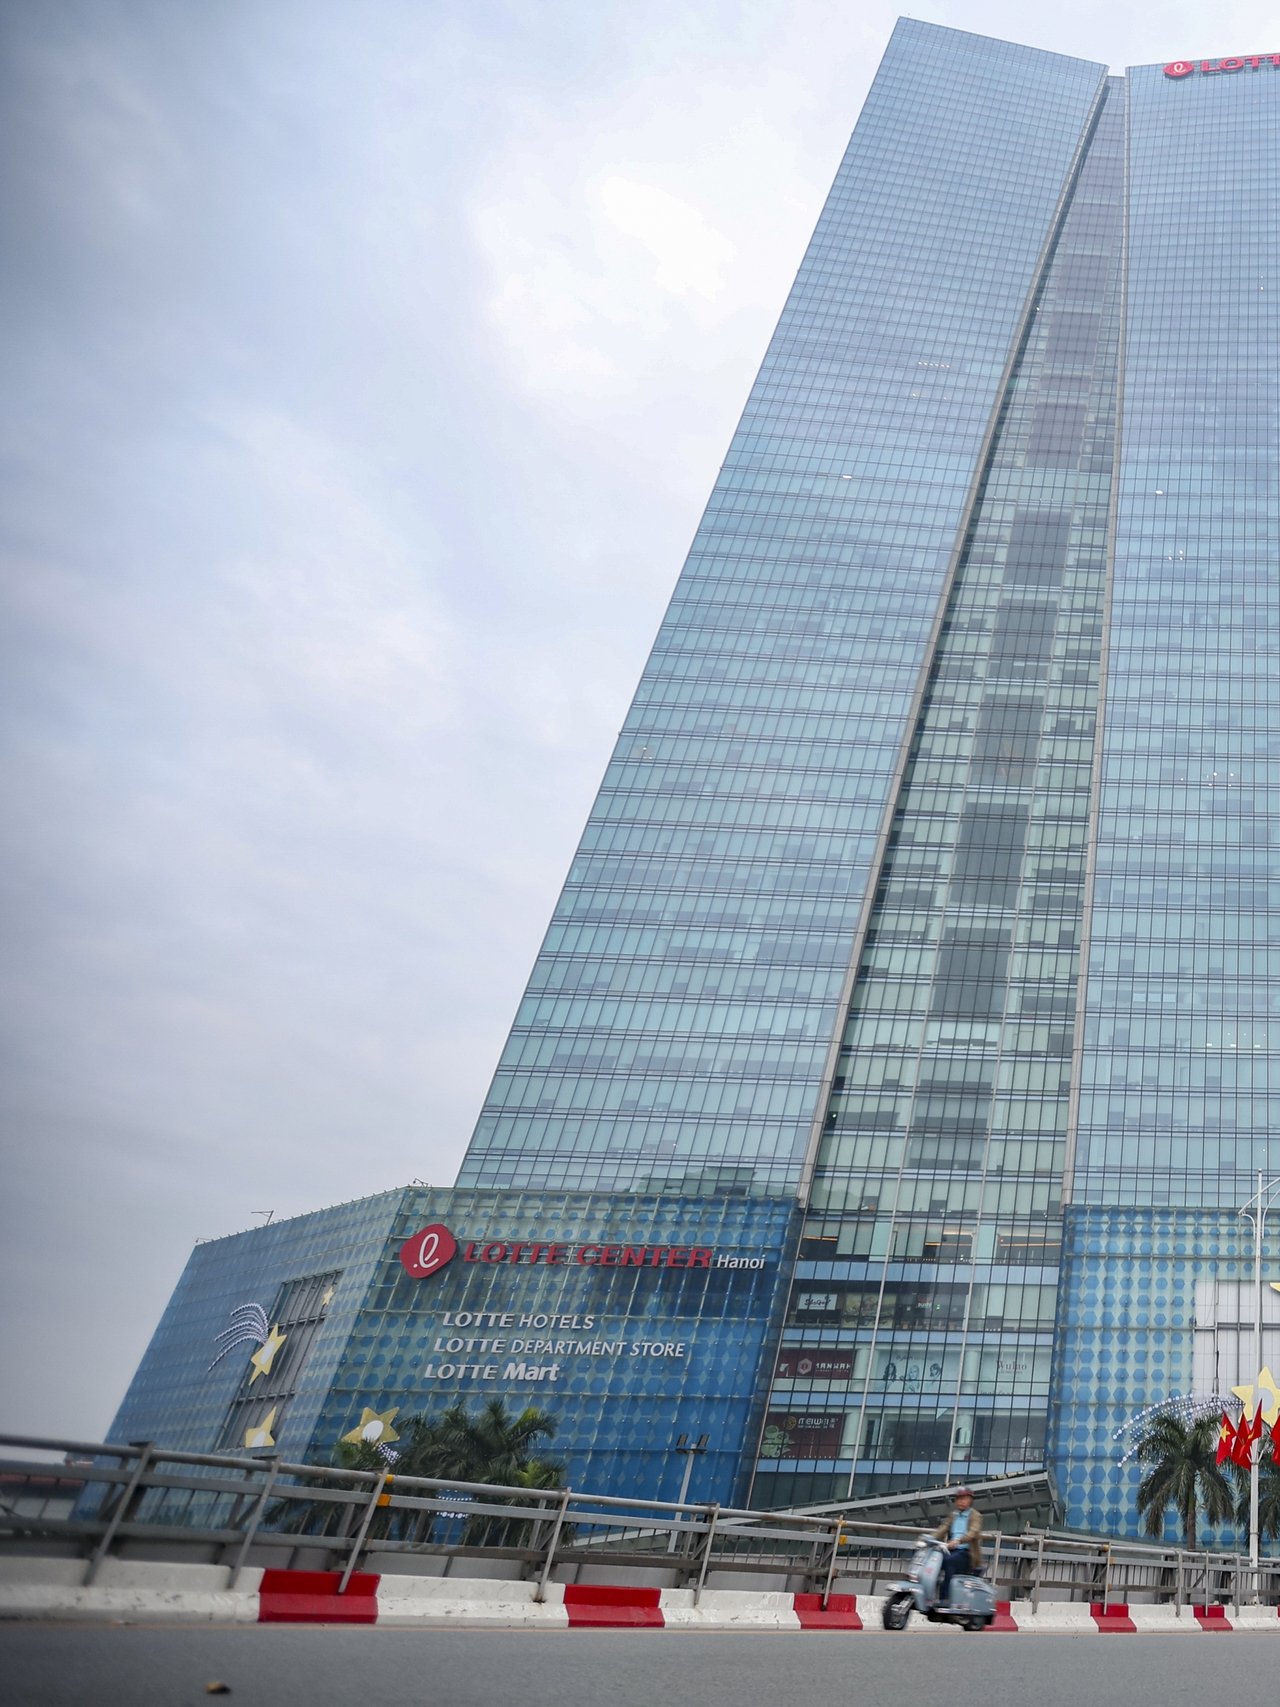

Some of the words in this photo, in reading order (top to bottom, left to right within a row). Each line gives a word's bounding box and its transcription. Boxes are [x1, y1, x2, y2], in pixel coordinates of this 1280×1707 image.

[463, 1243, 568, 1264] LOTTE
[576, 1245, 713, 1268] CENTER
[717, 1254, 766, 1269] Hanoi
[442, 1312, 515, 1328] LOTTE
[518, 1314, 595, 1330] HOTELS
[433, 1338, 507, 1353] LOTTE
[510, 1339, 627, 1356] DEPARTMENT
[629, 1342, 686, 1357] STORE
[424, 1363, 499, 1379] LOTTE
[502, 1362, 560, 1381] Mart
